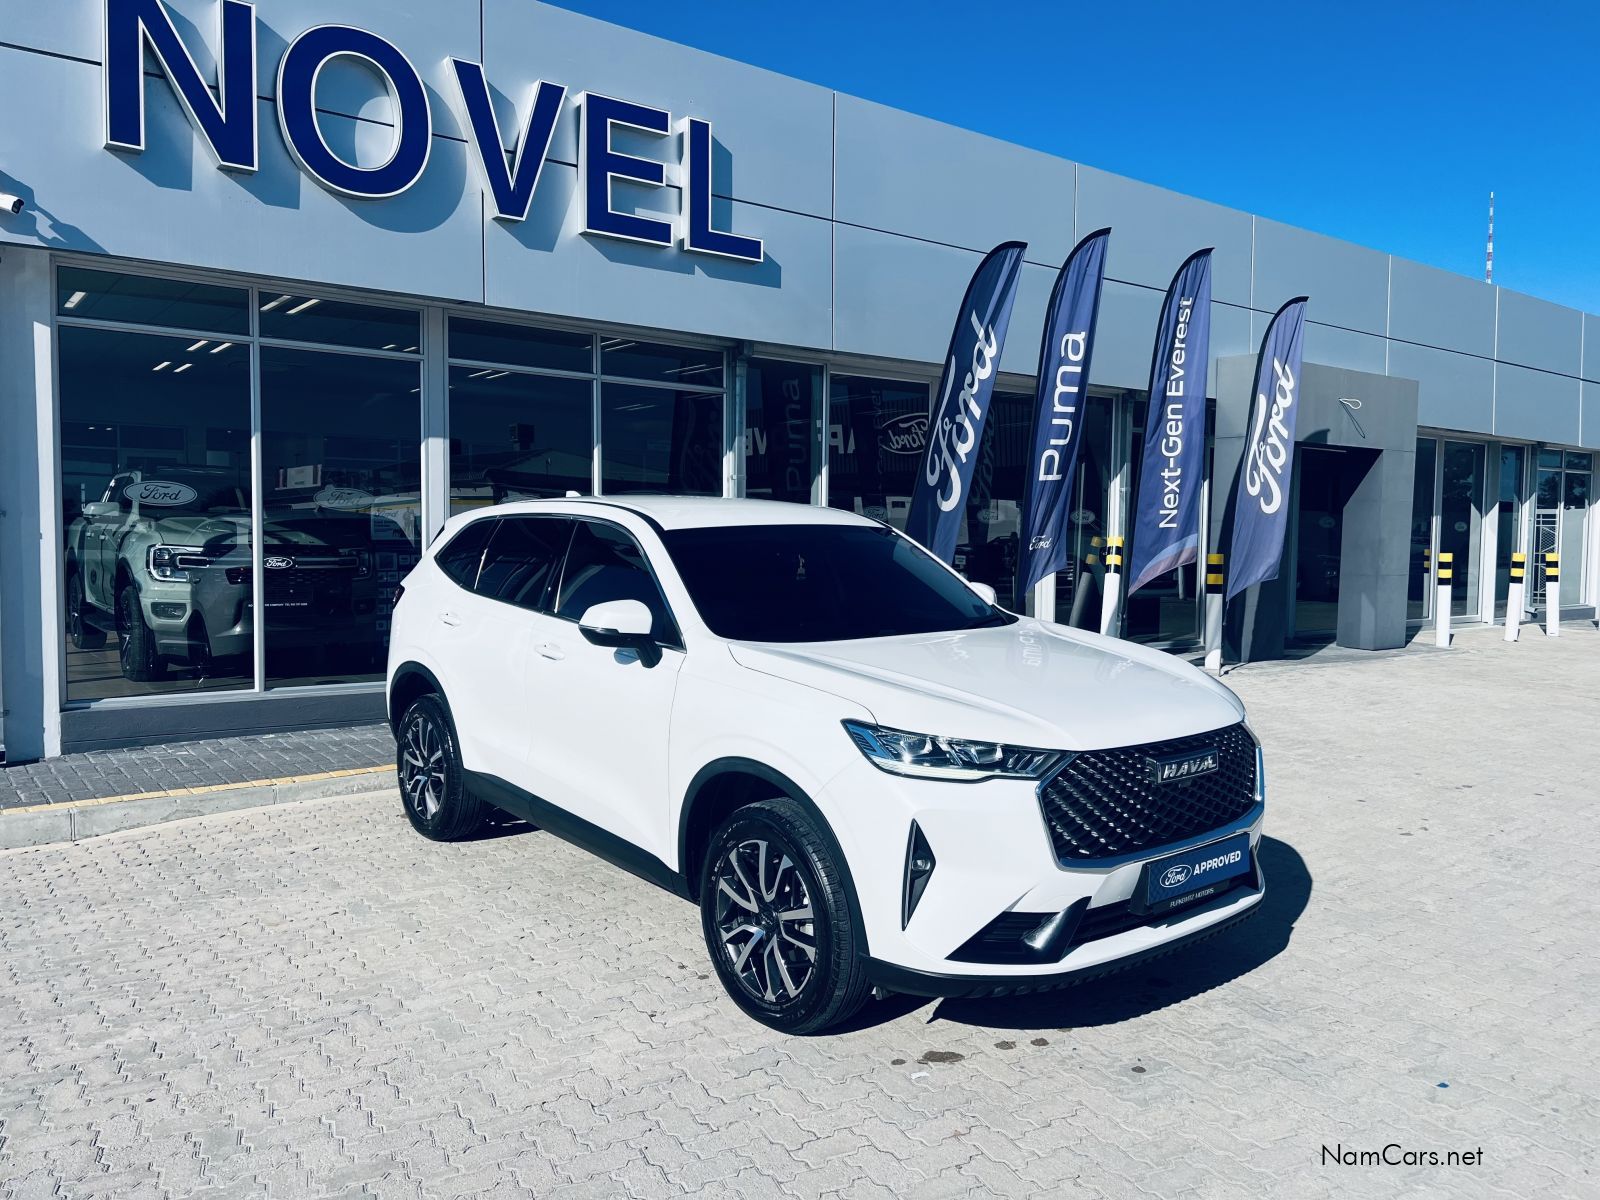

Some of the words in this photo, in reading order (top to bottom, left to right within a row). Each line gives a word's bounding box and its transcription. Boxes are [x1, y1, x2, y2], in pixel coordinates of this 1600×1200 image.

[102, 0, 764, 263] NOVEL
[1166, 297, 1193, 397] Everest
[926, 309, 998, 512] Ford
[1038, 331, 1086, 482] Puma
[1246, 357, 1296, 515] Ford
[140, 484, 182, 500] Ford
[1158, 402, 1183, 529] Next-Gen
[266, 558, 288, 567] Ford
[1029, 535, 1052, 550] Ford
[1162, 755, 1217, 779] HAVAL
[1165, 868, 1187, 885] Ford
[1193, 850, 1242, 876] APPROVED
